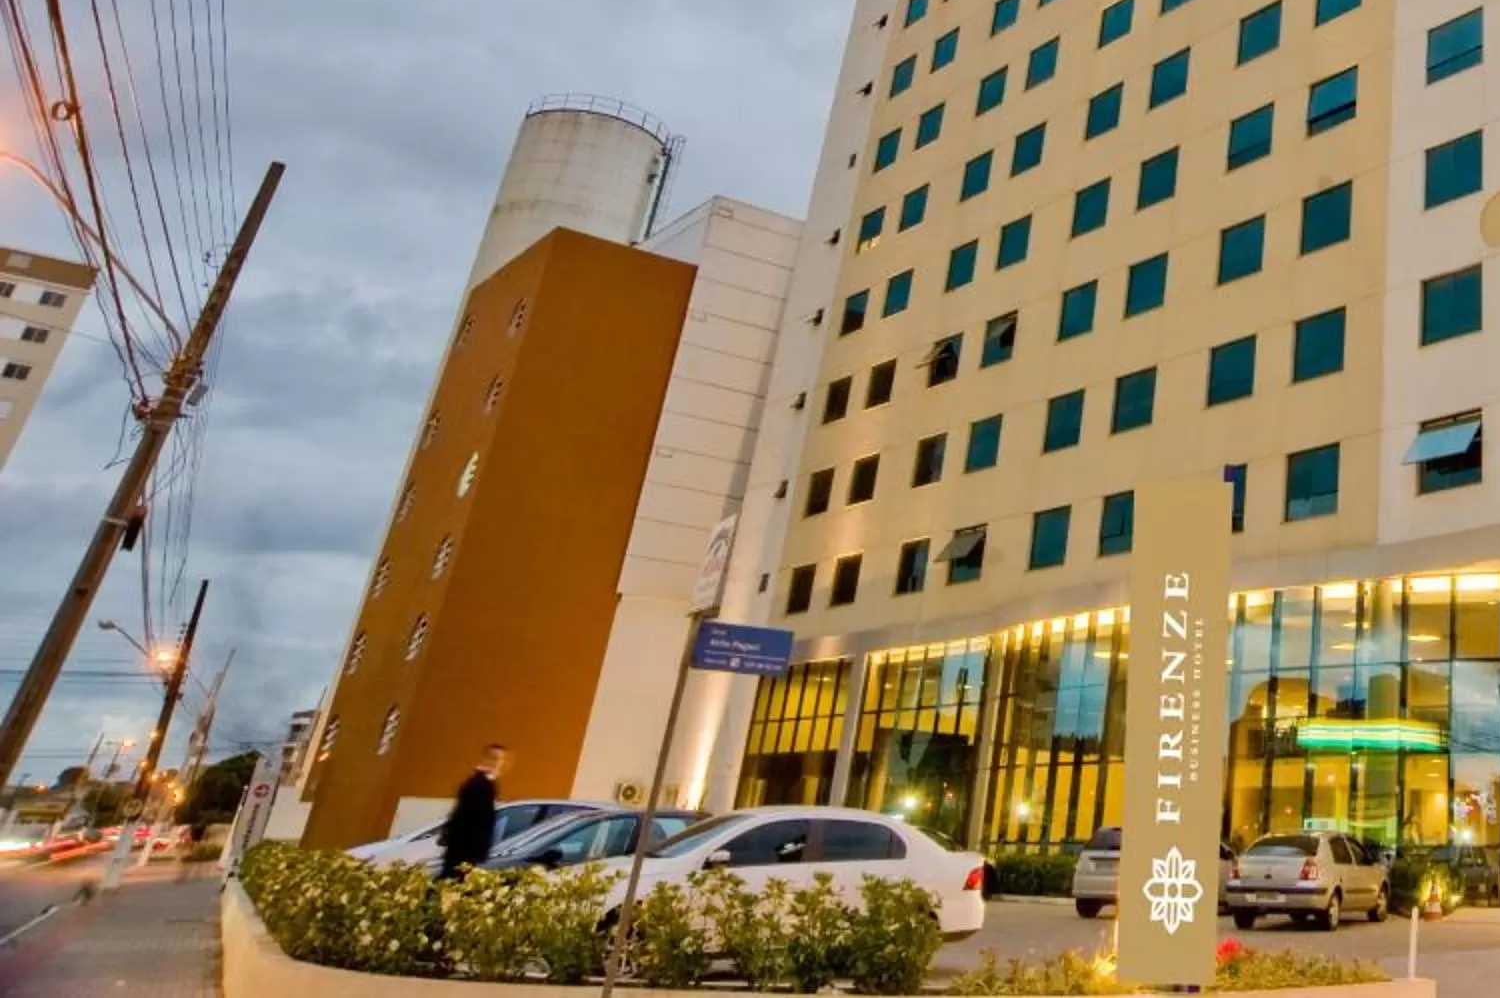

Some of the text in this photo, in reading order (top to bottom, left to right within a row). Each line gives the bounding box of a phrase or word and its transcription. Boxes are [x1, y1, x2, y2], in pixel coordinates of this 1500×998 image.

[1156, 572, 1190, 825] FIRENZE
[1189, 617, 1204, 782] BUSINESS HOTEL
